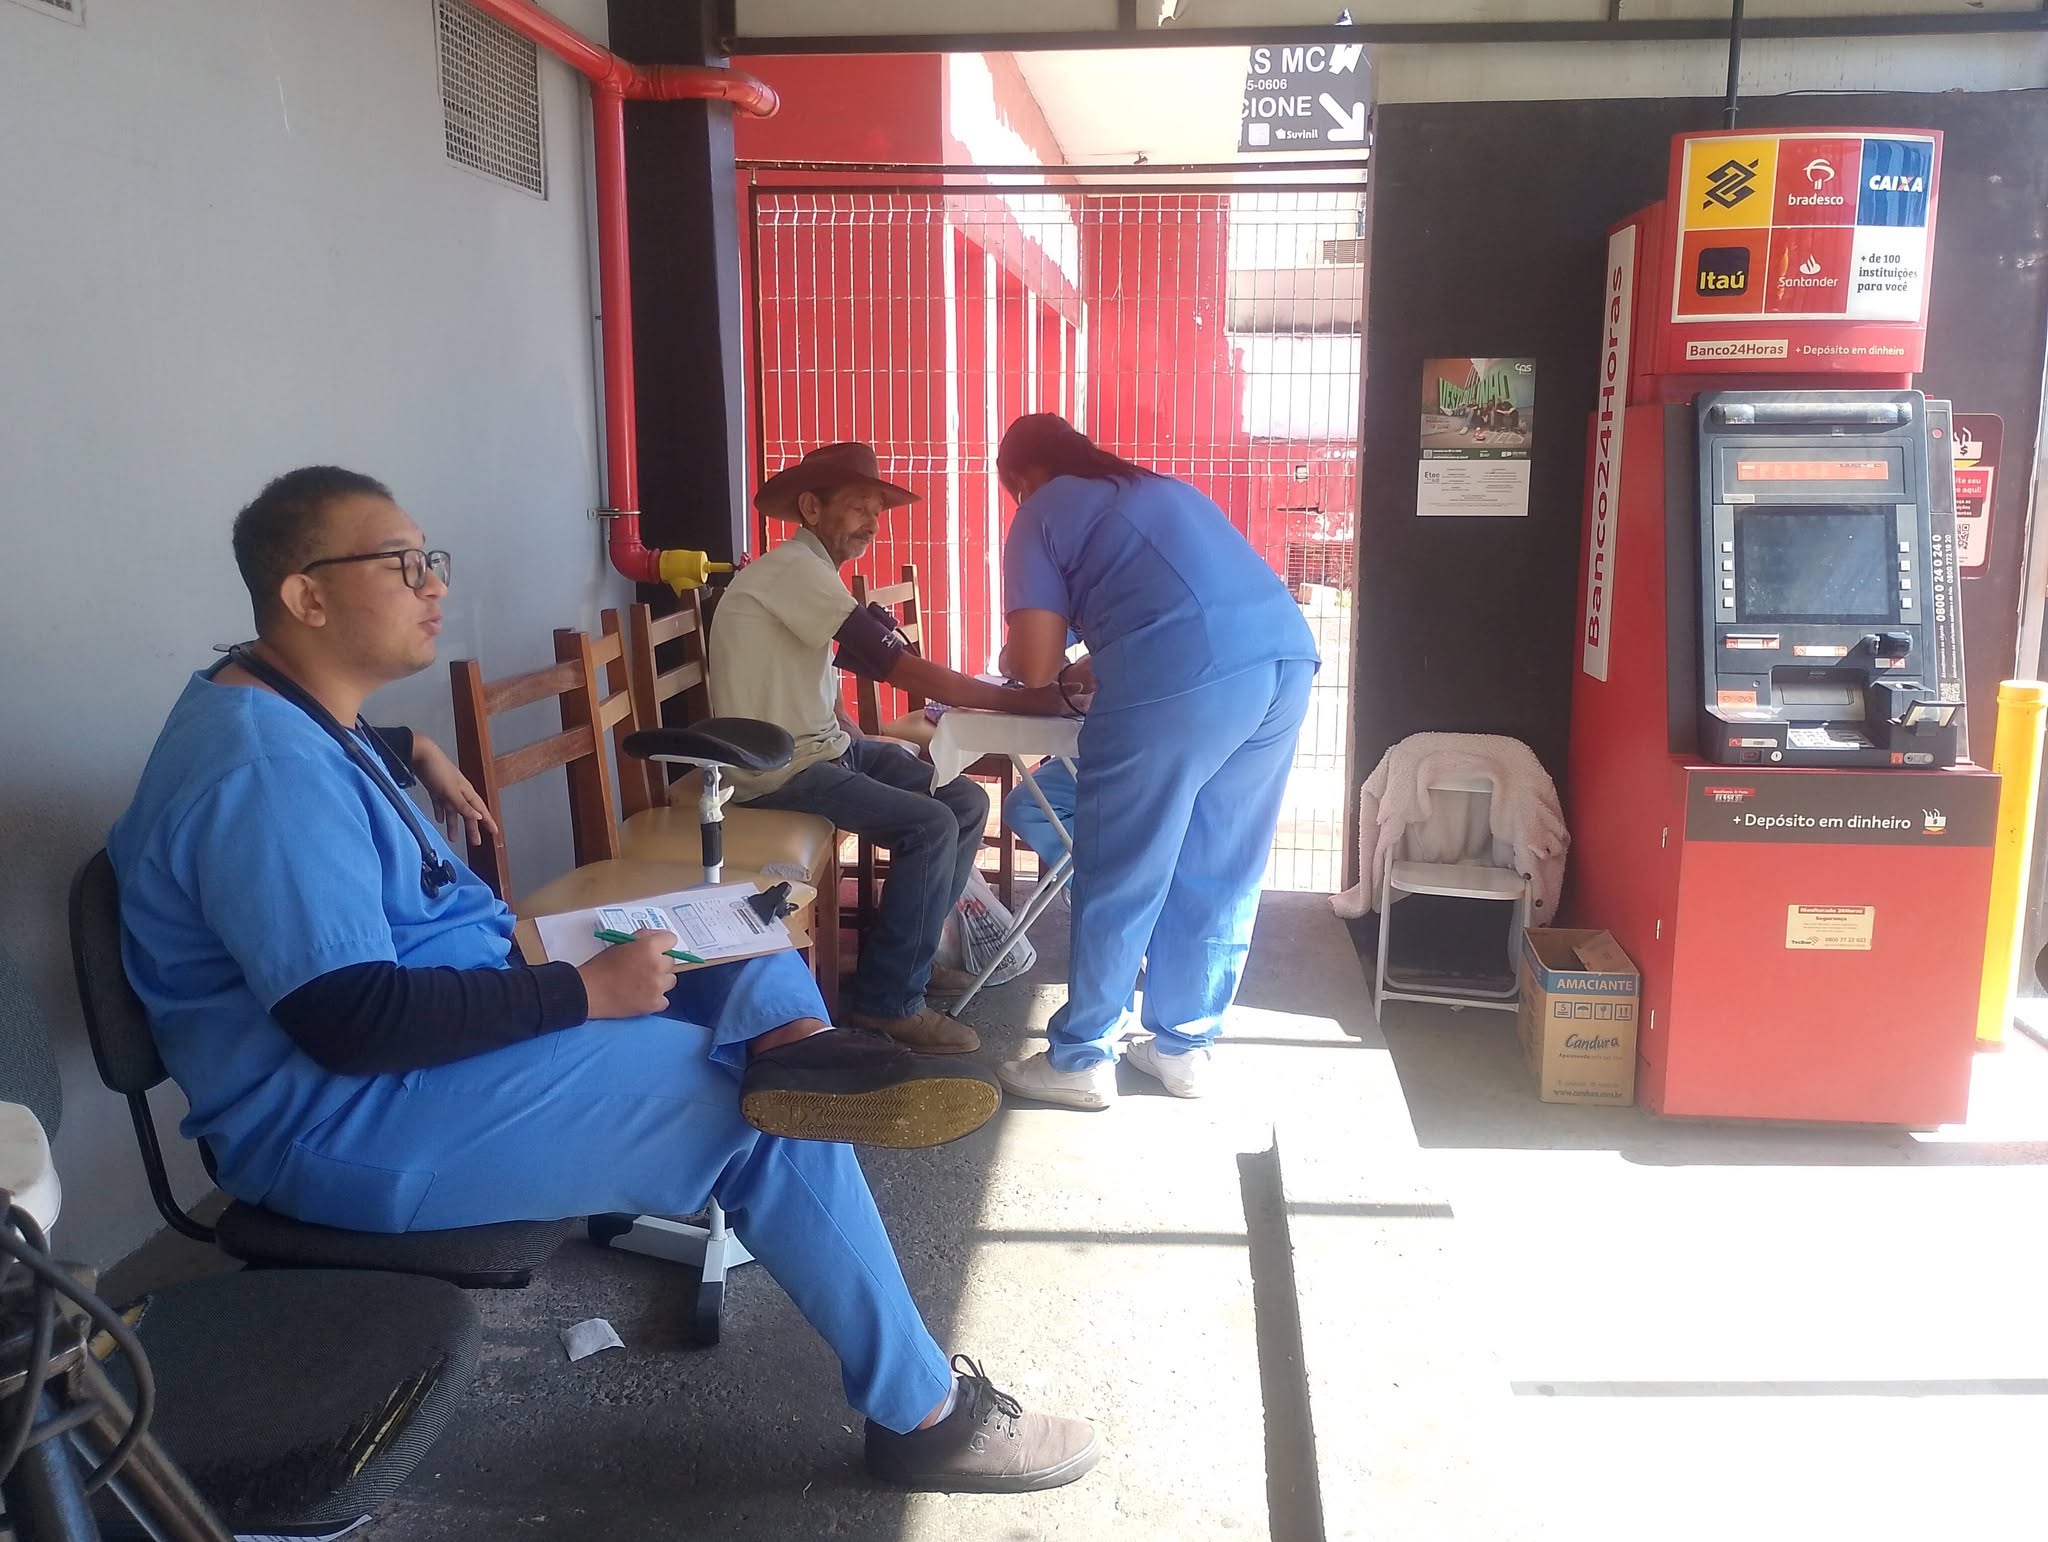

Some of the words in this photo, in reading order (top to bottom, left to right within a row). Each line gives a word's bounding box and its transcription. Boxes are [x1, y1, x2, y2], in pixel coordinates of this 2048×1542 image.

[1286, 128, 1318, 139] Suvinil
[1869, 175, 1923, 192] CAIXA
[1788, 193, 1844, 206] bradesco
[1868, 253, 1881, 264] de
[1883, 253, 1901, 264] 100
[1858, 266, 1918, 280] instituições
[1699, 270, 1745, 290] Itaú
[1777, 276, 1839, 288] Santander
[1857, 282, 1883, 293] para
[1885, 281, 1908, 292] você
[1690, 344, 1784, 357] Banco24Horas
[1803, 345, 1850, 357] Depósito
[1851, 347, 1867, 355] em
[1868, 346, 1905, 356] dinheiro
[1588, 264, 1622, 648] Banco24Horas
[1932, 534, 1942, 542] 0
[1932, 543, 1942, 557] 24
[1933, 559, 1943, 567] 0
[1933, 569, 1944, 582] 24
[1935, 594, 1946, 622] 0800
[1745, 814, 1815, 830] Depósito
[1819, 817, 1843, 828] em
[1847, 815, 1911, 830] dinheiro
[1557, 978, 1633, 991] AMACIANTE
[1565, 1033, 1620, 1050] Candura
